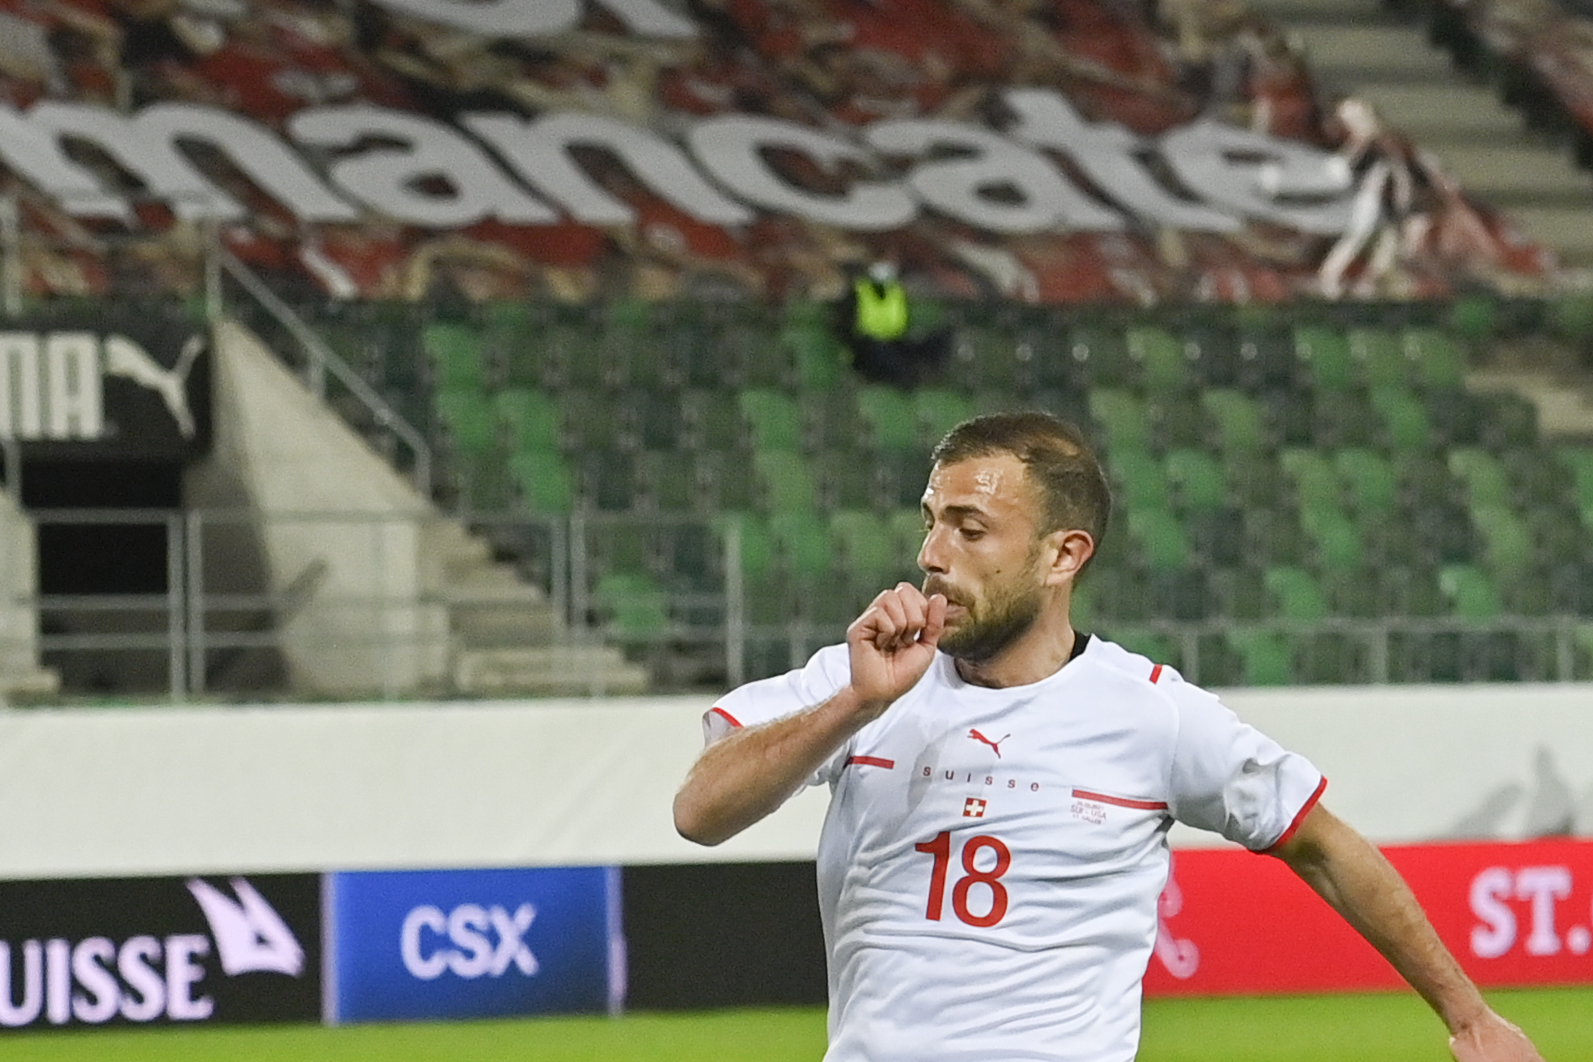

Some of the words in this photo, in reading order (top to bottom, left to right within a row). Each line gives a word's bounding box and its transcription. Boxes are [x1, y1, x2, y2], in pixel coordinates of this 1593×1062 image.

[922, 765, 1040, 793] suisse
[914, 831, 1012, 928] 18
[1469, 865, 1591, 959] ST.
[399, 902, 540, 981] CSX
